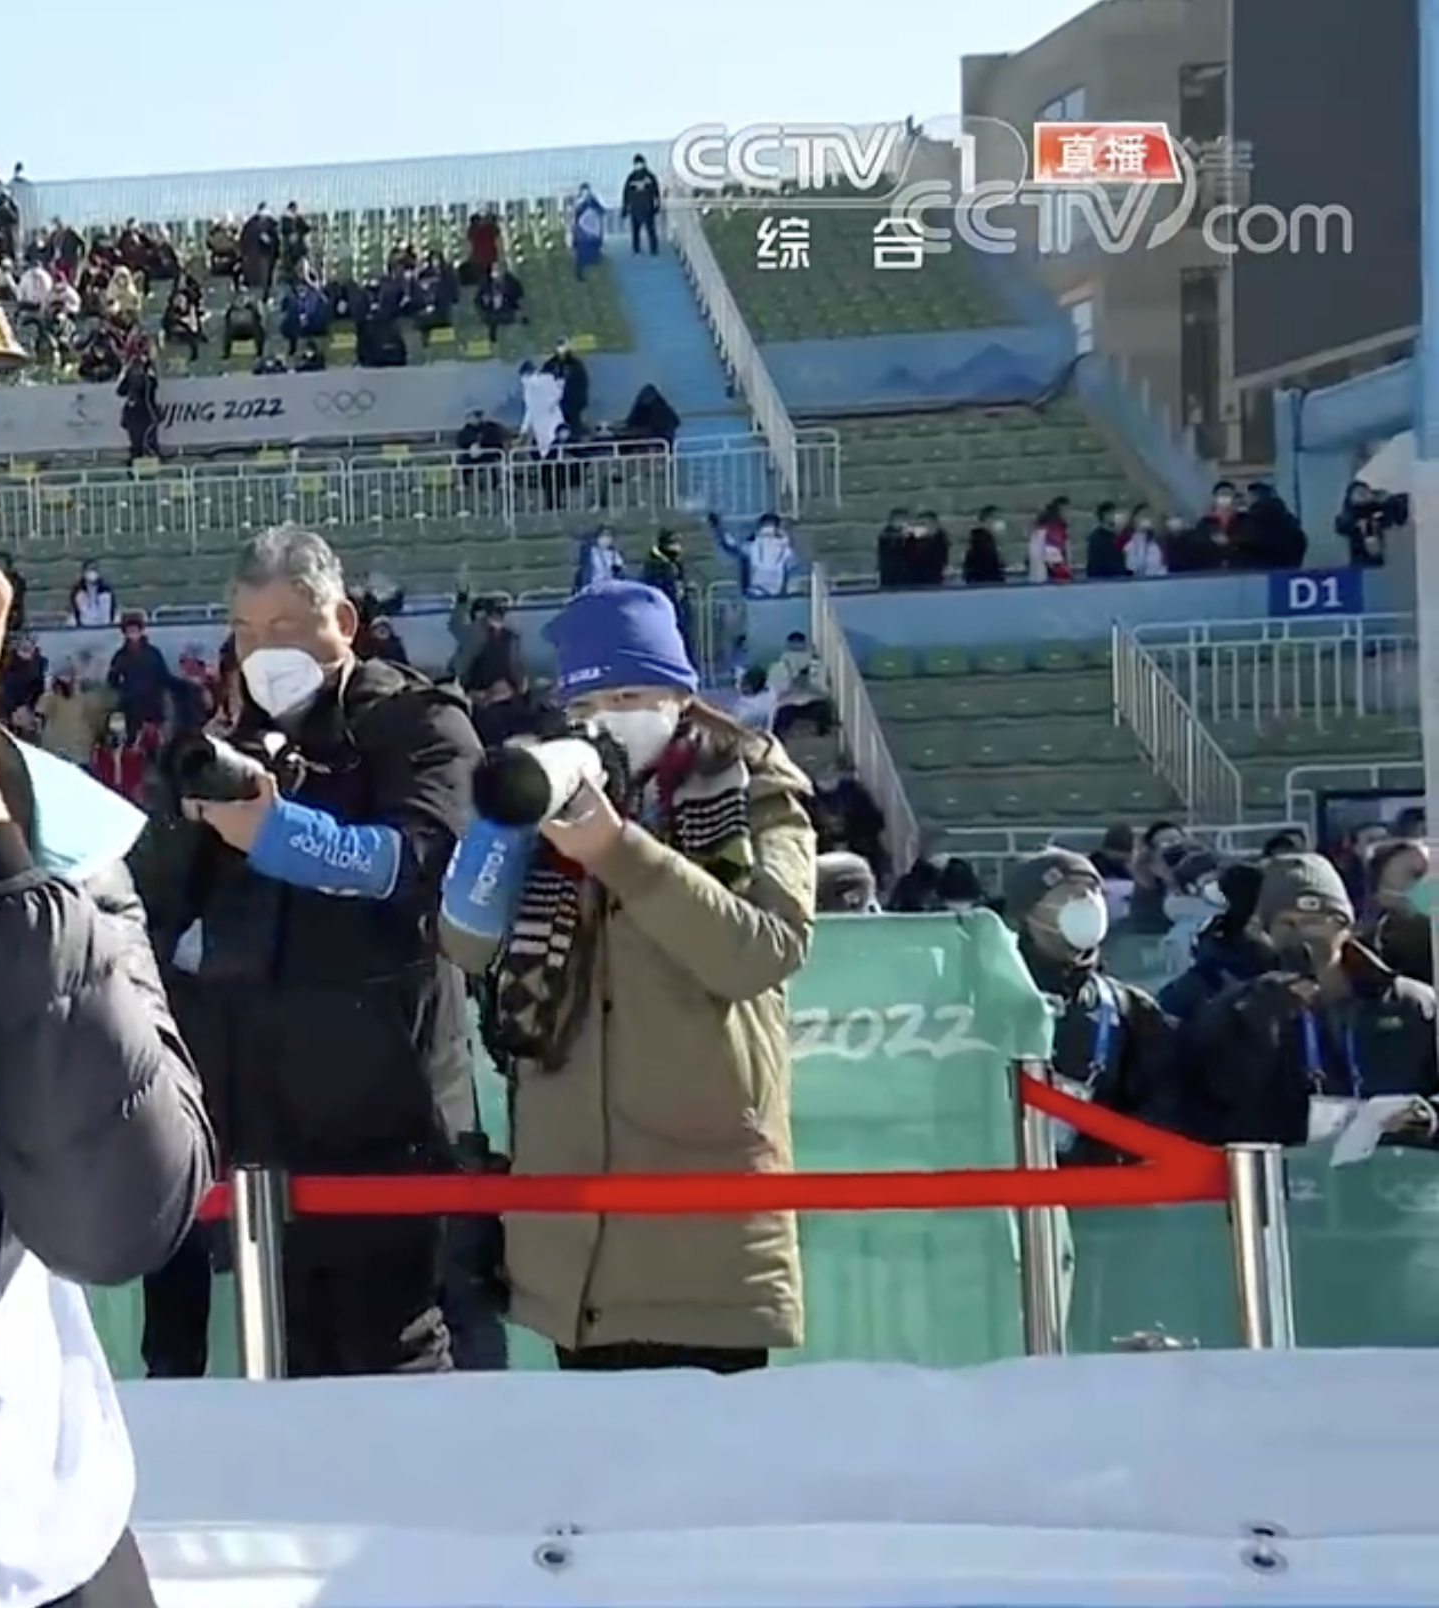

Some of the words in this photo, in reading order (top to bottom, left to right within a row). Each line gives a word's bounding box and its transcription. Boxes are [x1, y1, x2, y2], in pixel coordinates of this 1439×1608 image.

[223, 398, 286, 420] 2022
[1289, 577, 1343, 608] D1
[789, 1003, 998, 1060] 2022
